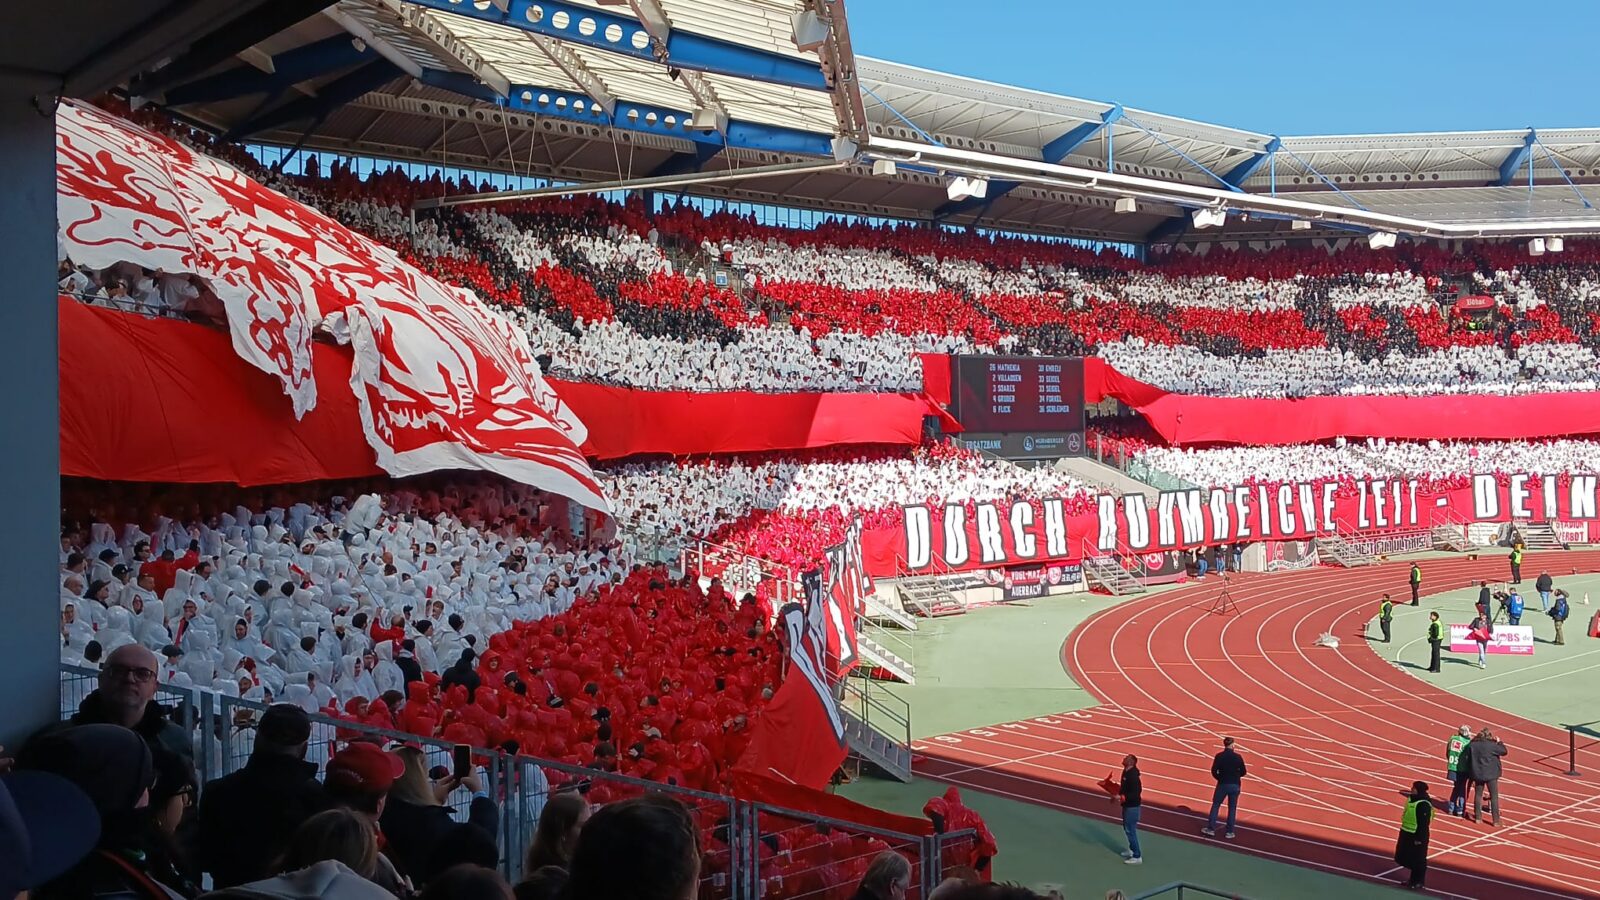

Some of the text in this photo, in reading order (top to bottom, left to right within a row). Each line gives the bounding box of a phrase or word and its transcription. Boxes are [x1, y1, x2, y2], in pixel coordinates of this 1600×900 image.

[902, 497, 1068, 570] DURCH
[1356, 478, 1418, 531] ZEIT
[1472, 472, 1599, 520] DEIN
[1011, 584, 1042, 597] AUERBACH
